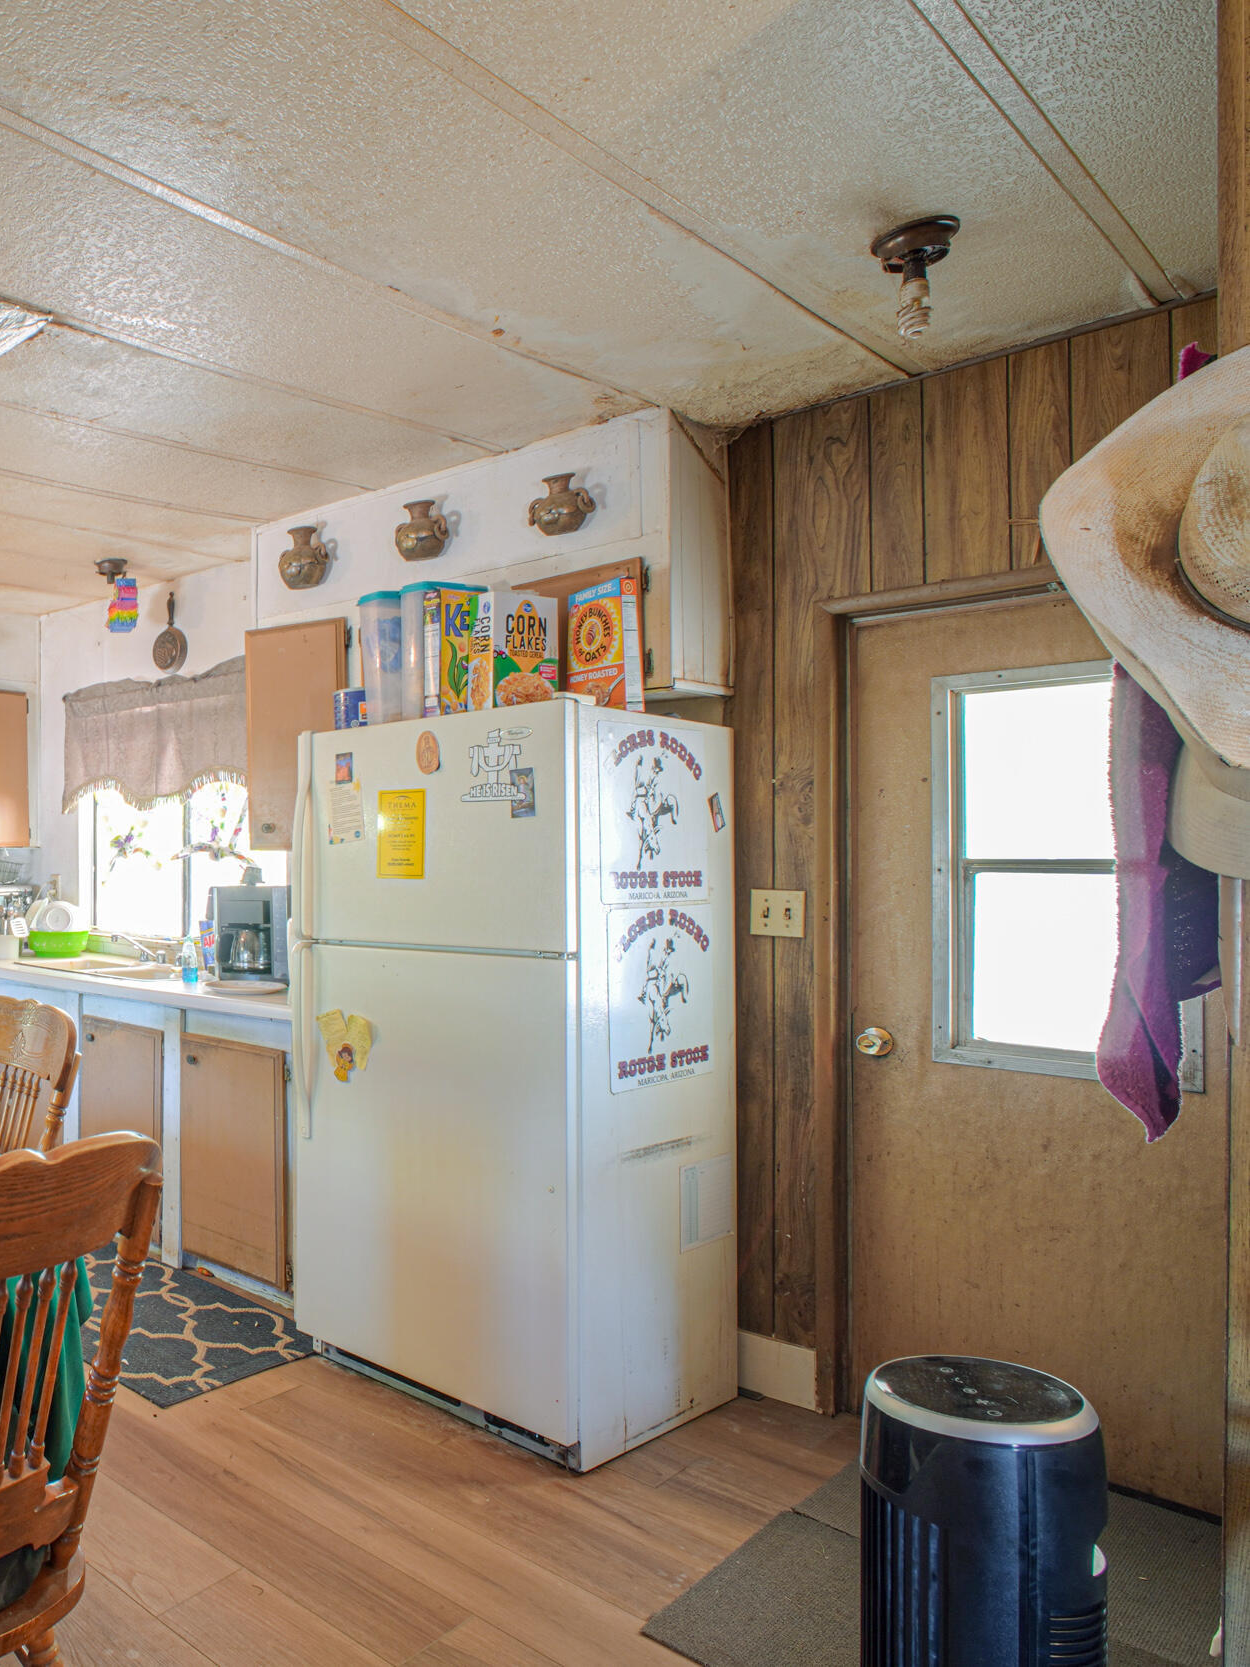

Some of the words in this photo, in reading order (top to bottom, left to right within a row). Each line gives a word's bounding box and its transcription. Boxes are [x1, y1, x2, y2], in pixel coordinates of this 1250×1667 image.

[575, 588, 596, 603] FAMILY
[480, 616, 491, 653] CORN
[506, 614, 547, 637] CORN
[575, 612, 588, 645] HONEY
[588, 607, 611, 638] BUNCHES
[505, 635, 547, 651] FLAKES
[584, 644, 607, 662] OATS
[588, 667, 618, 680] ROASTED
[612, 729, 655, 767] LORES
[659, 731, 702, 781] RODEO
[470, 784, 482, 797] HE
[482, 783, 491, 797] IS
[492, 783, 518, 797] RISEN
[662, 870, 703, 888] STOCK
[662, 890, 688, 899] ARIZONA
[617, 908, 664, 958] LORES
[668, 908, 710, 952] RODEO
[618, 1053, 666, 1079] ROUGH
[670, 1044, 710, 1068] STOCK
[670, 1068, 696, 1080] ARIZONA
